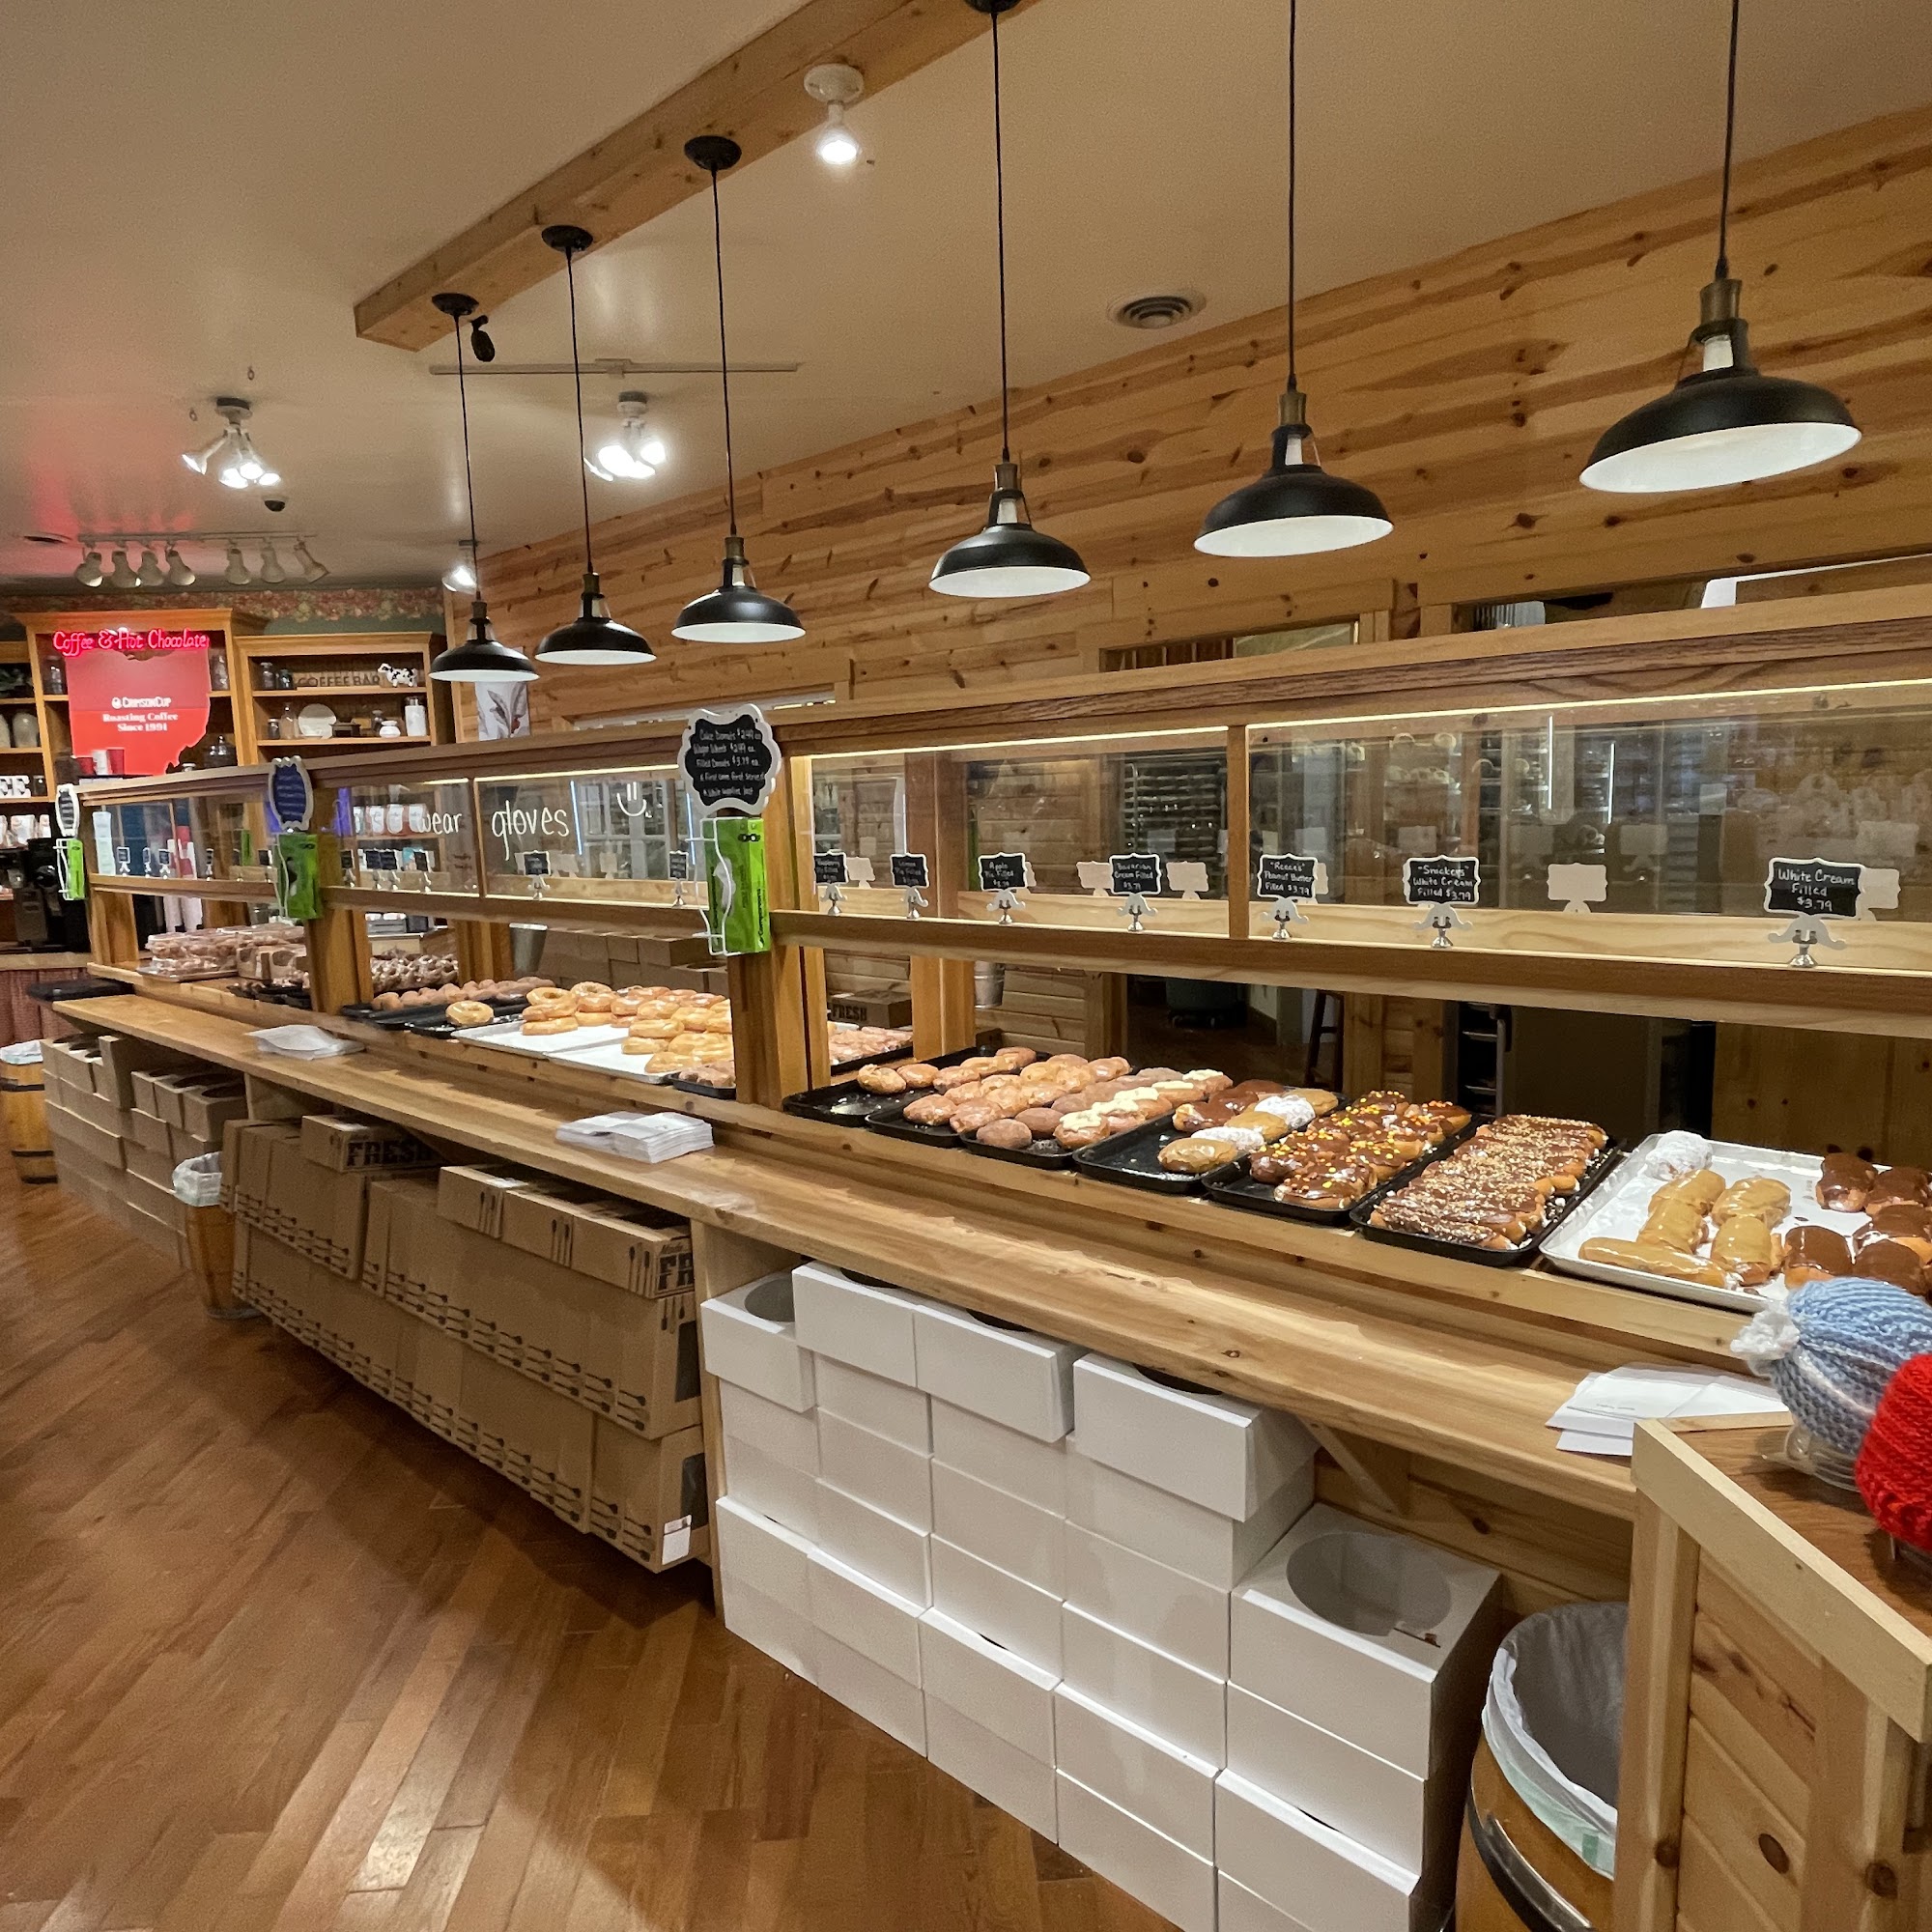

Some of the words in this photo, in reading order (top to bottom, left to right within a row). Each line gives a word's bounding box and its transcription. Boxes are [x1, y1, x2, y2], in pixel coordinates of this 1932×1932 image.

[53, 630, 94, 657] Coffee
[98, 629, 113, 648] &
[114, 628, 144, 649] Hot
[148, 628, 208, 648] Chocolate
[298, 676, 351, 687] COFFEE
[353, 674, 381, 686] BAR
[102, 712, 147, 724] Roasting
[147, 712, 179, 722] Coffee
[117, 723, 144, 732] Since
[145, 723, 168, 732] 1991
[417, 811, 463, 836] wear
[491, 799, 570, 862] gloves
[1114, 870, 1134, 879] Cream
[1135, 870, 1154, 879] Filled
[1264, 870, 1289, 881] Peanut
[1778, 867, 1812, 882] White
[1814, 868, 1856, 886] Cream
[1264, 881, 1284, 891] Filled
[1412, 876, 1438, 886] White
[1440, 876, 1473, 887] Cream
[1417, 887, 1443, 897] Filled
[1445, 888, 1471, 900] $3.79
[1791, 882, 1828, 896] Filled
[1797, 895, 1833, 912] $3.79
[831, 1004, 867, 1021] FRESH
